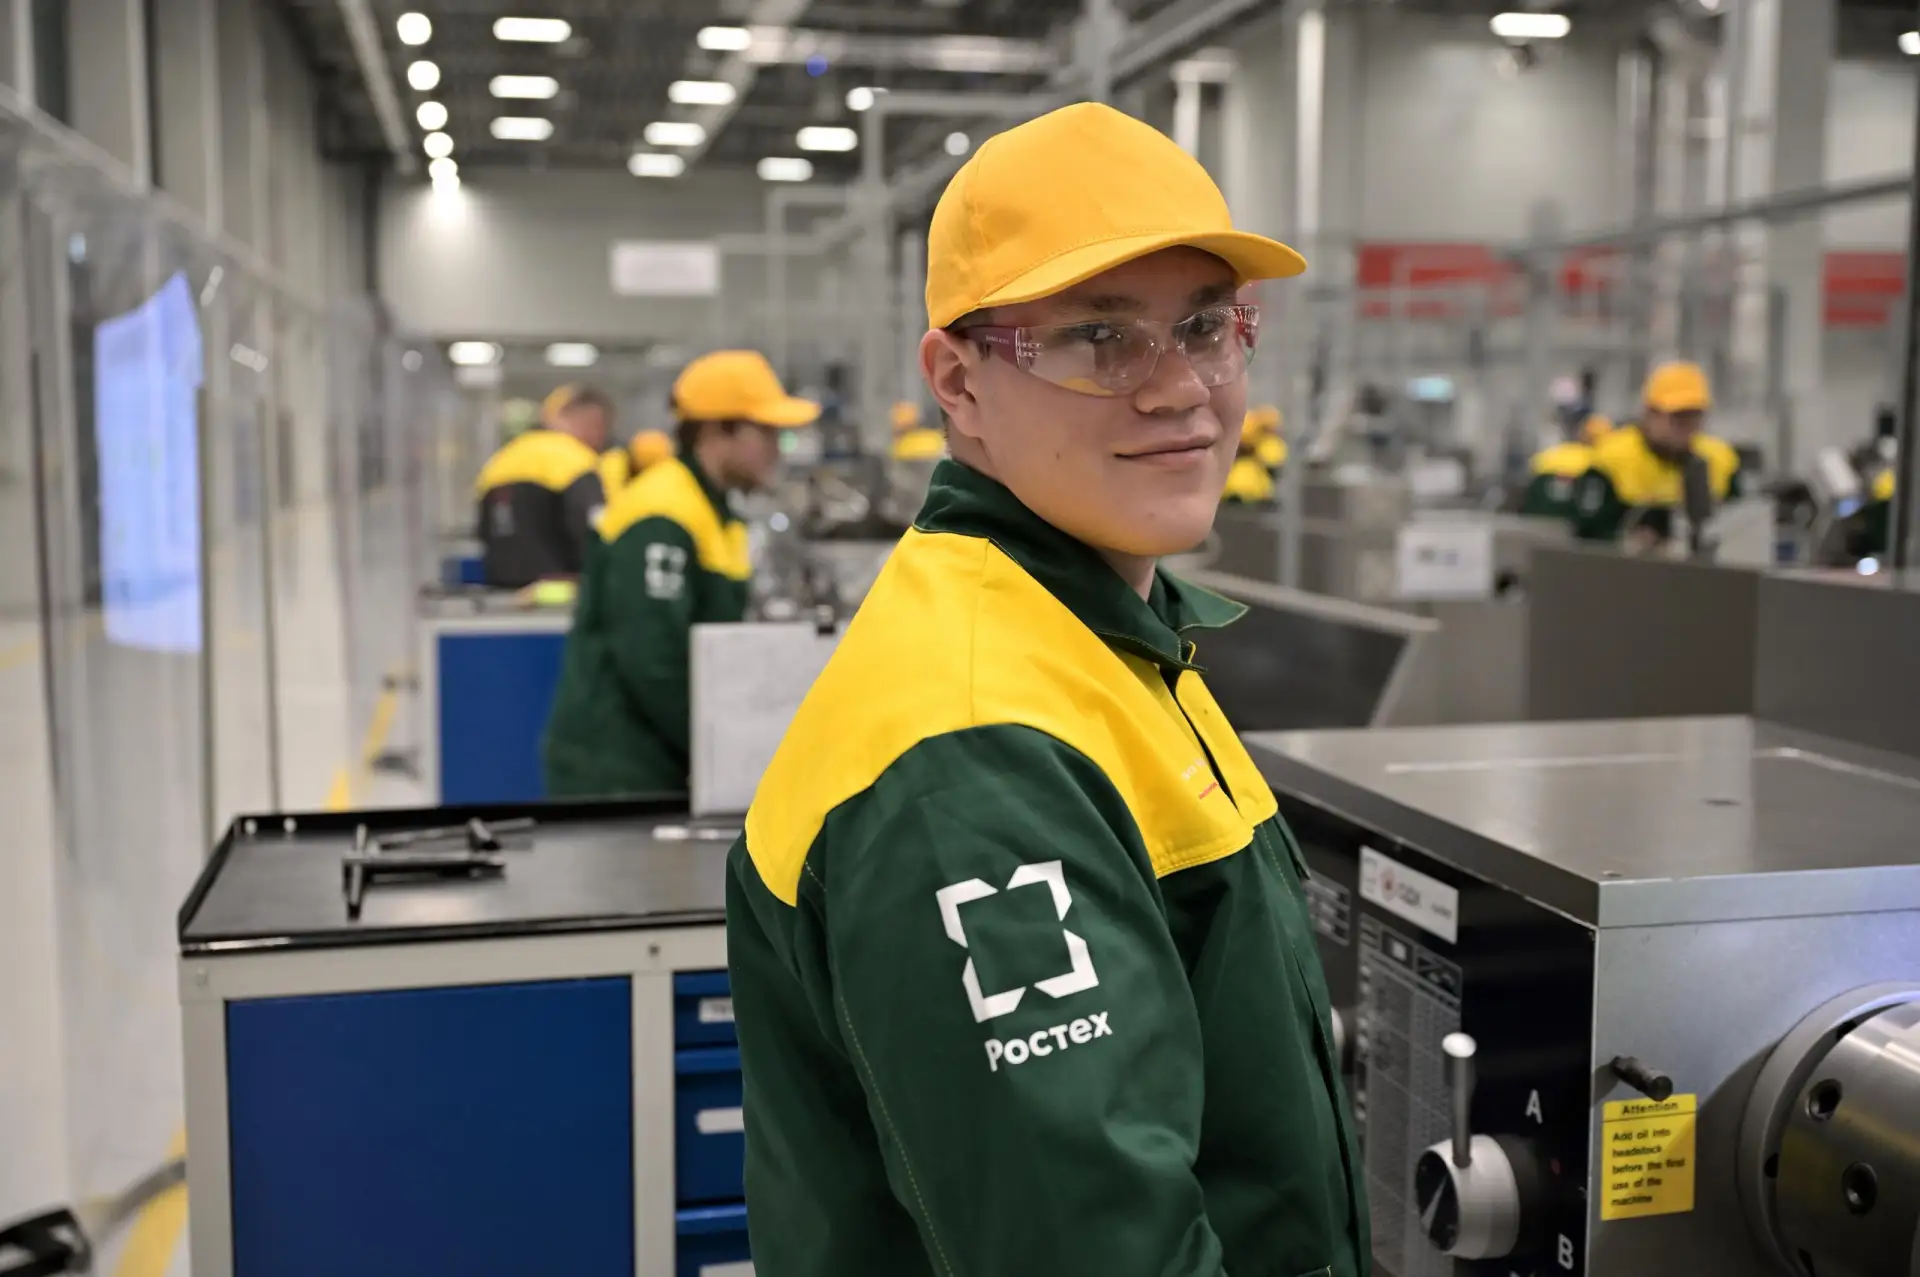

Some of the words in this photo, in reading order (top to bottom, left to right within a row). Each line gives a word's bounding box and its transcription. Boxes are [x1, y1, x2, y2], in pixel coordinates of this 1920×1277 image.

[985, 1011, 1113, 1072] Ростех
[1525, 1089, 1543, 1124] A
[1622, 1102, 1679, 1115] Attention
[1612, 1132, 1633, 1141] Add
[1637, 1129, 1648, 1139] oil
[1653, 1128, 1671, 1137] into
[1612, 1145, 1662, 1158] headstock
[1612, 1164, 1642, 1174] before
[1647, 1161, 1662, 1171] the
[1666, 1158, 1685, 1168] first
[1612, 1181, 1628, 1190] use
[1634, 1178, 1644, 1188] of
[1647, 1177, 1662, 1187] the
[1611, 1195, 1653, 1206] machine
[1558, 1233, 1573, 1270] B
